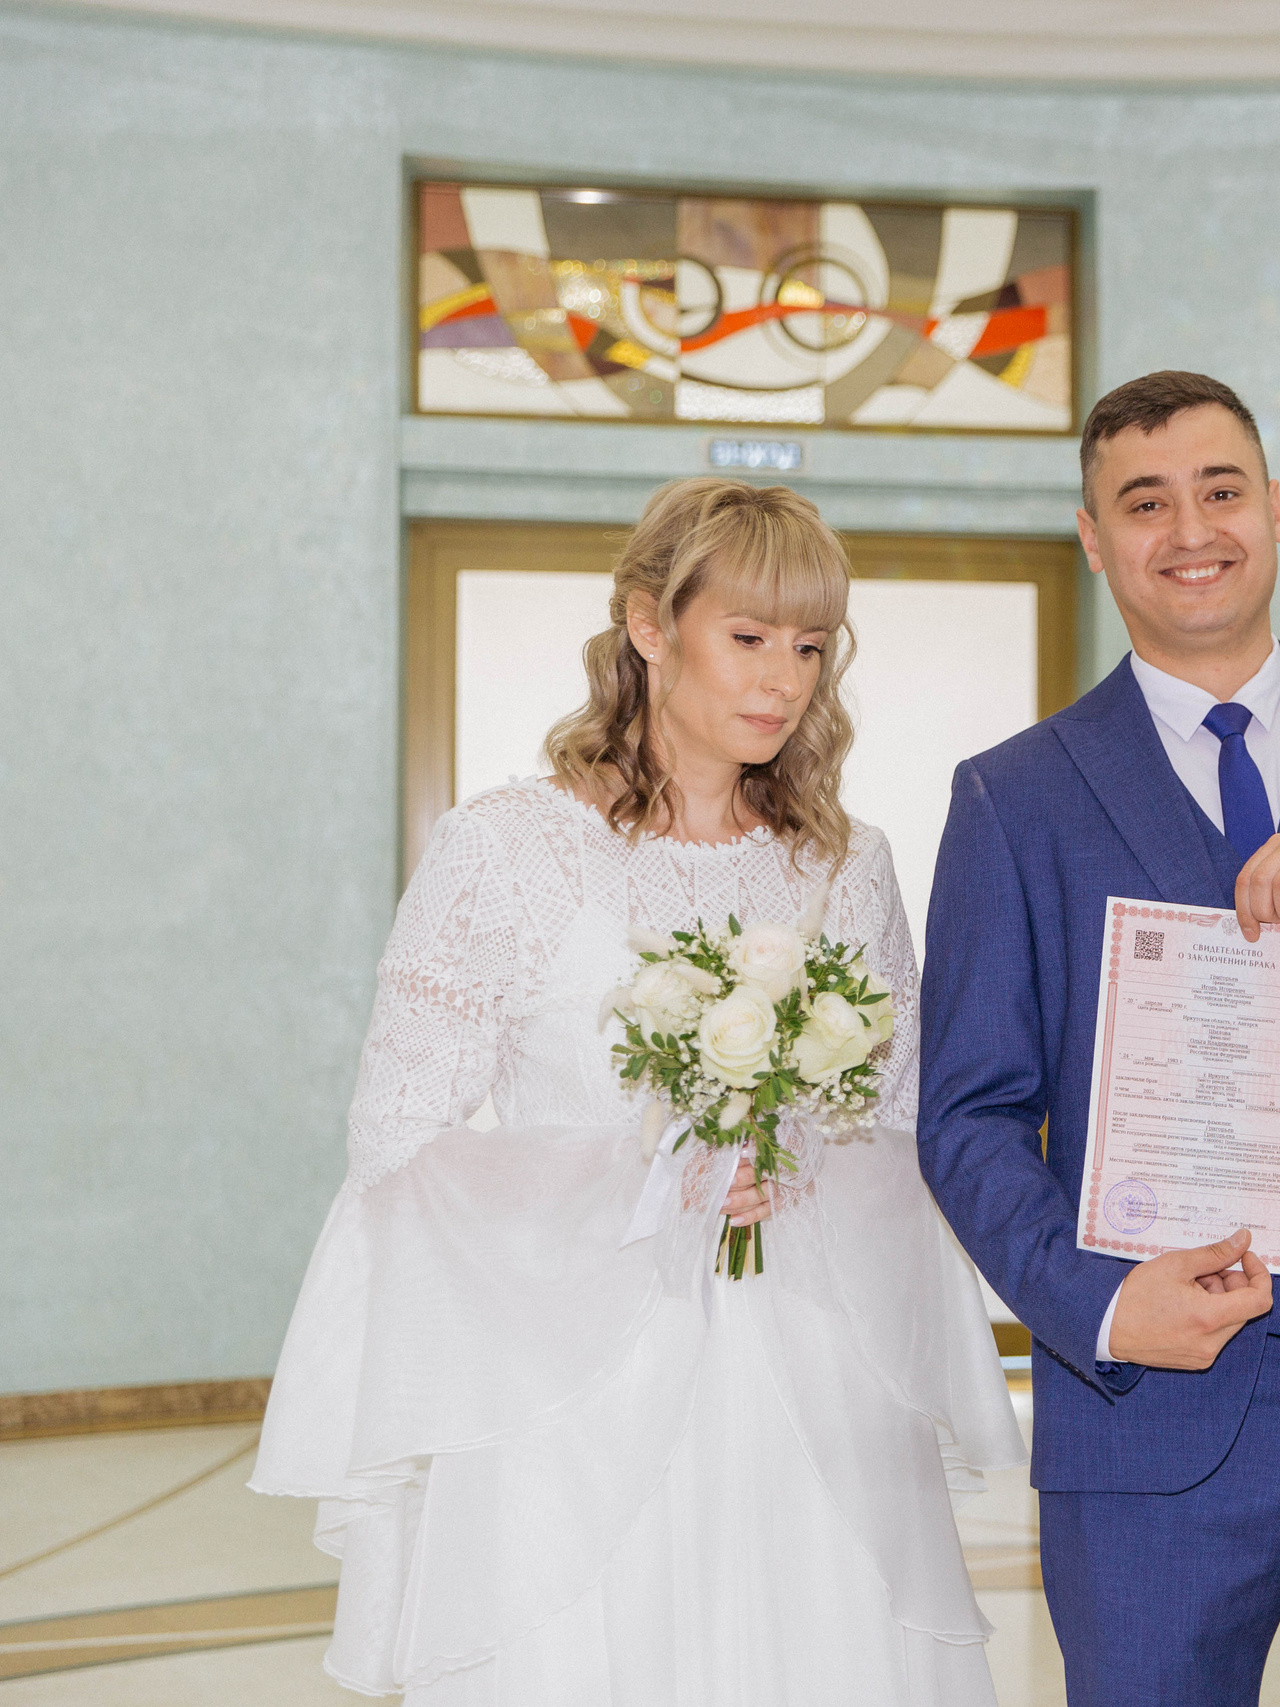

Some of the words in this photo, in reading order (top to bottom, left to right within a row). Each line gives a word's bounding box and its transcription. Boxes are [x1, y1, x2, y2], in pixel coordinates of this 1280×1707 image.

[1192, 943, 1263, 958] СВИДЕТЕЛЬСТВО
[1186, 953, 1246, 966] ЗАКЛЮЧЕНИИ
[1248, 959, 1276, 969] БРАКА
